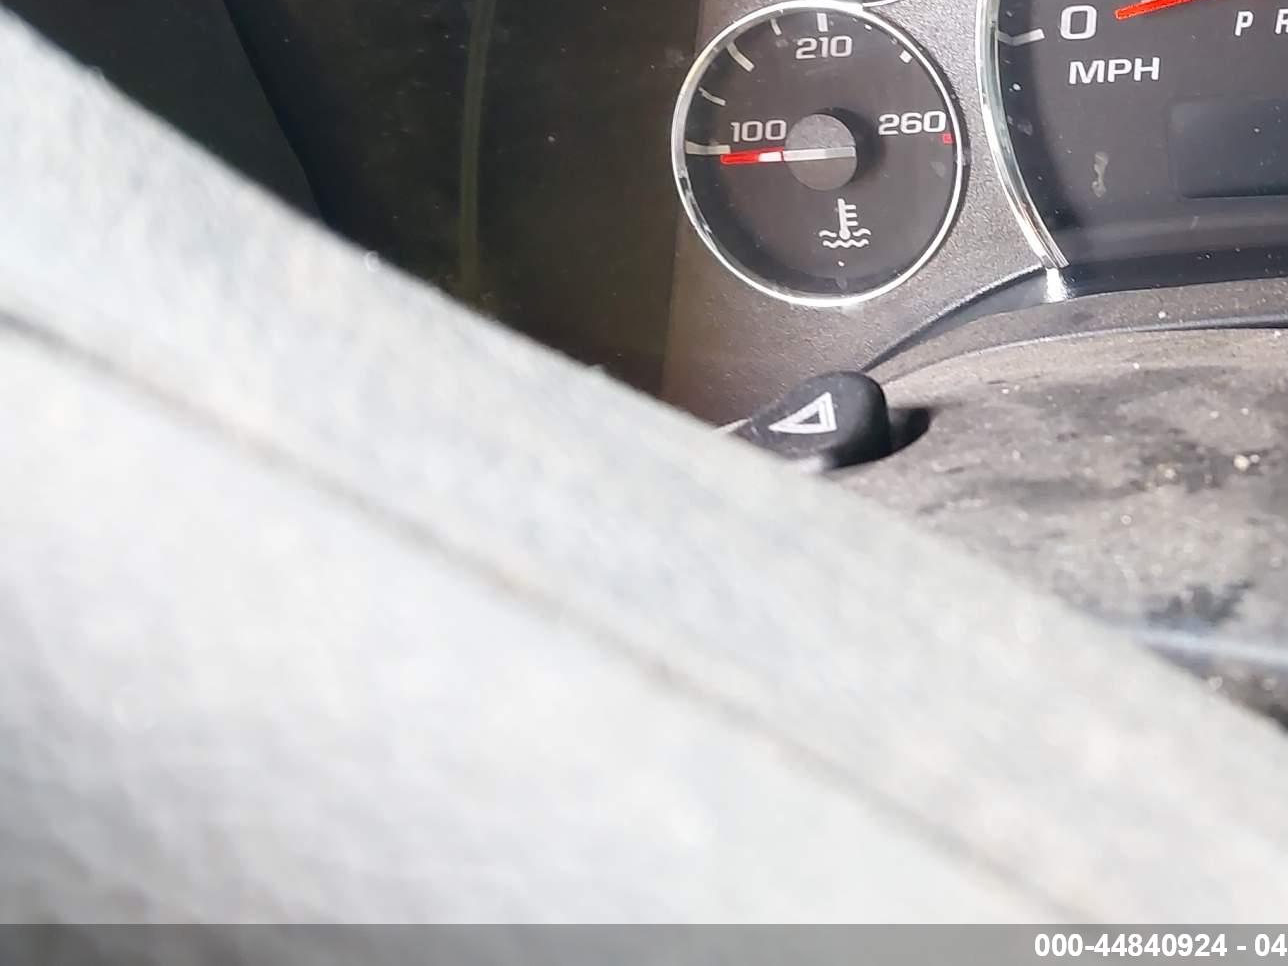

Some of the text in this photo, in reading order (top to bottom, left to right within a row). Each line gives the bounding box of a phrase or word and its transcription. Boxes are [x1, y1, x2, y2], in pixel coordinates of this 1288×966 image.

[1060, 6, 1096, 39] 0
[796, 36, 852, 59] 210
[1069, 57, 1159, 84] MPH
[730, 119, 787, 142] 100
[879, 111, 946, 134] 260
